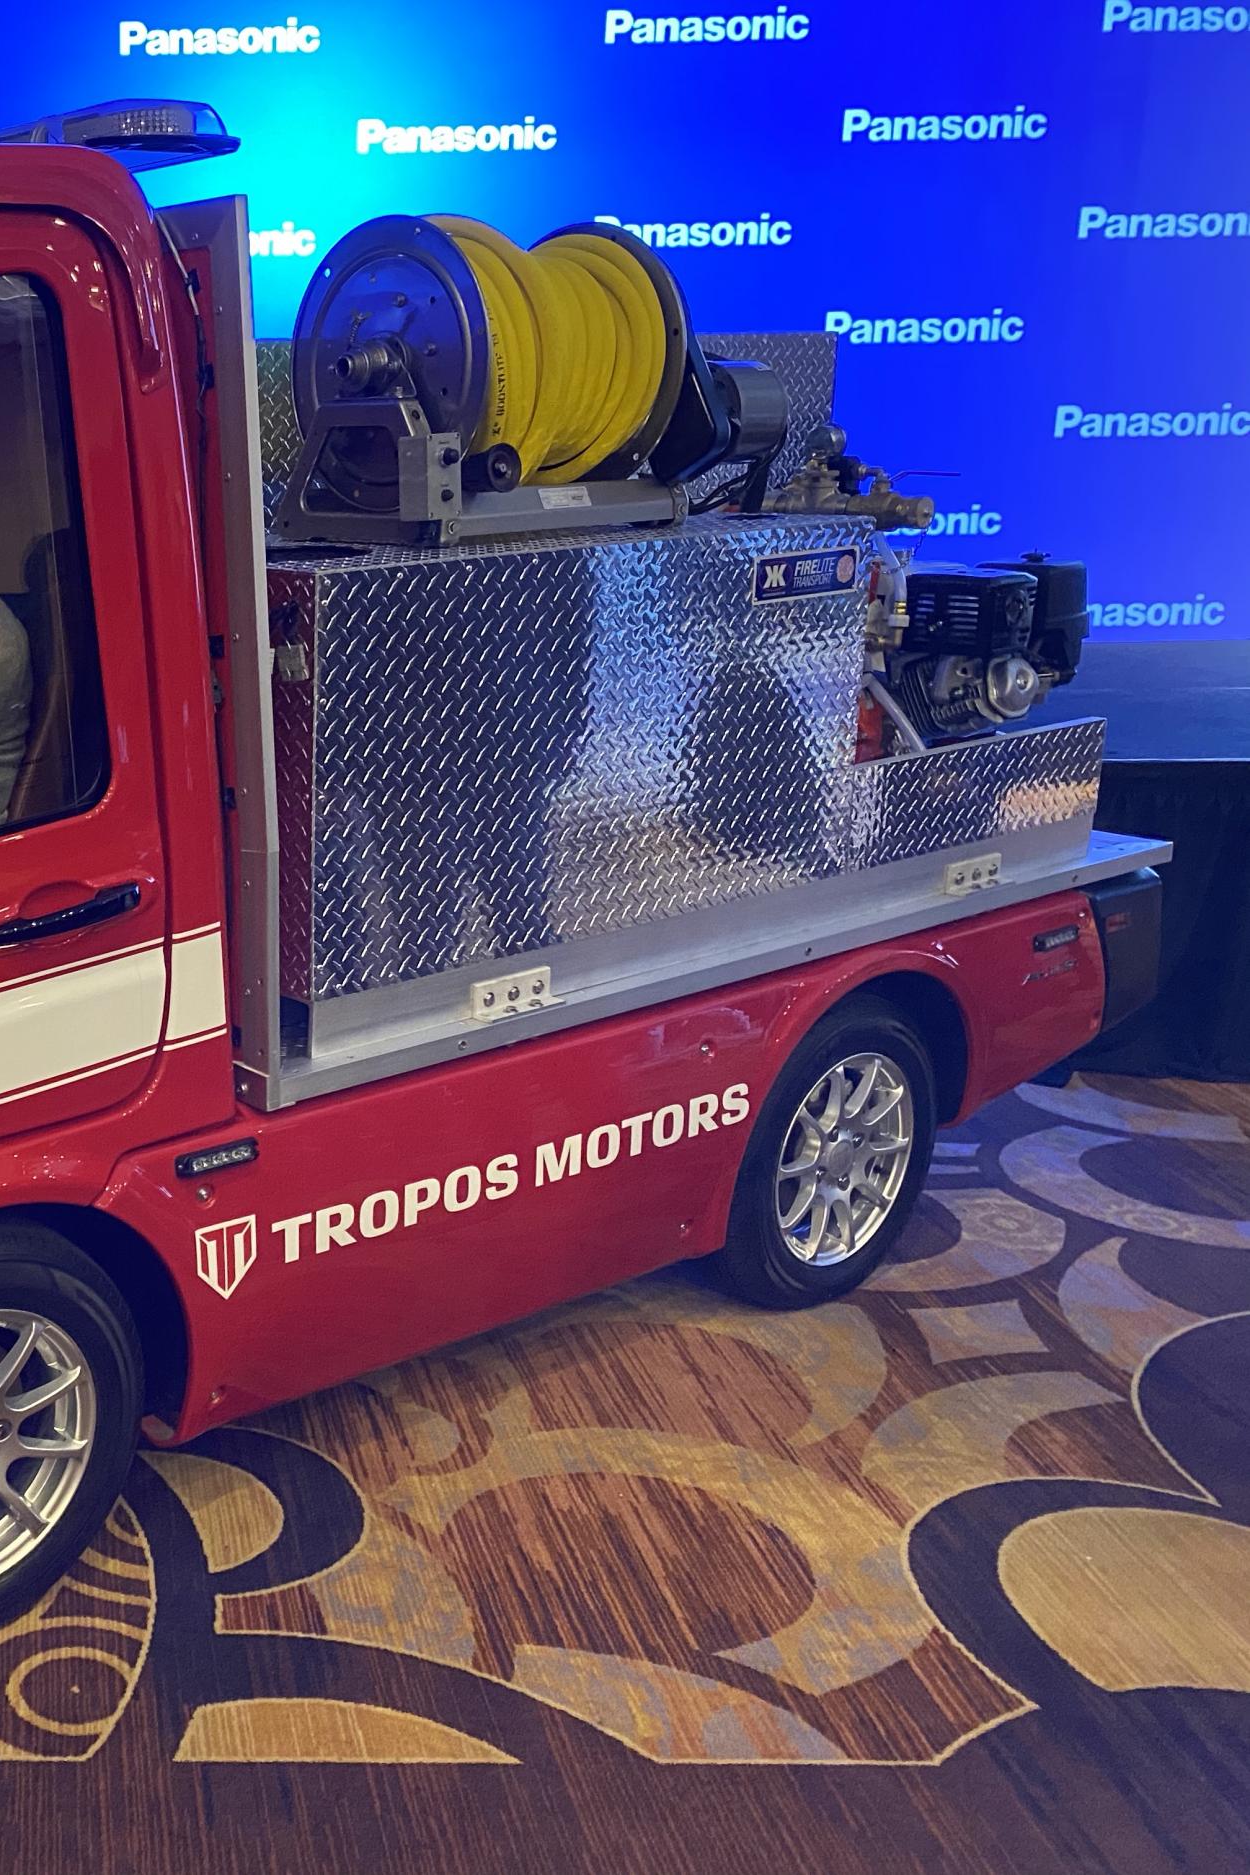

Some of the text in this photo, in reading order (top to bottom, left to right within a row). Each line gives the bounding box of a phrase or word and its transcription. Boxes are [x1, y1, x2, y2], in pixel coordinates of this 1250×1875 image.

[119, 16, 321, 56] Panasonic
[604, 5, 810, 44] Panasonic
[356, 115, 557, 154] Panasonic
[842, 105, 1047, 142] Panasonic
[824, 308, 1024, 344] Panasonic
[1053, 402, 1250, 438] Panasonic
[271, 1083, 750, 1264] TROPOS MOTORS
